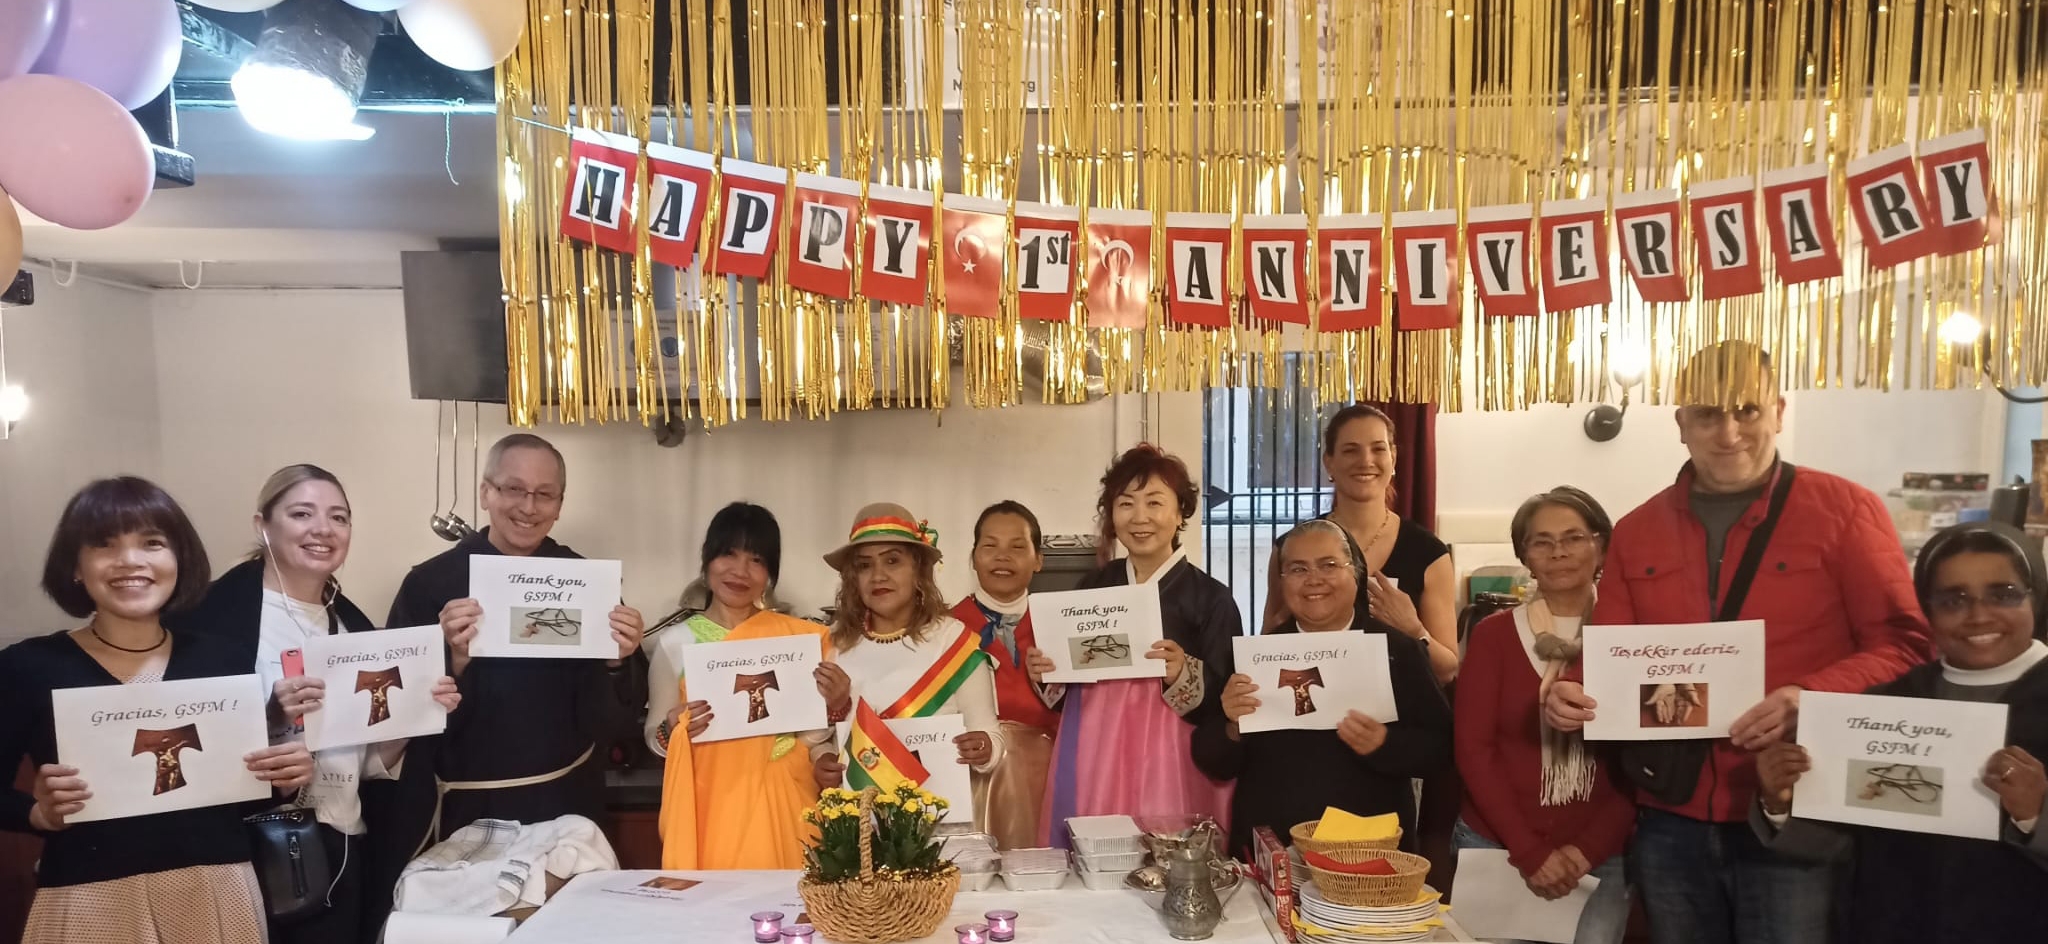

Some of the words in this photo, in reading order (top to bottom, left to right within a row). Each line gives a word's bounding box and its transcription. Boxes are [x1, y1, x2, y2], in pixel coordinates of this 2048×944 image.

[575, 163, 914, 274] HAPPY
[1021, 231, 1071, 290] 1st
[1183, 160, 1978, 306] ANNIVERSARY
[507, 573, 557, 589] Thank
[557, 578, 587, 590] you,
[1060, 604, 1101, 618] Thank
[1102, 605, 1129, 618] you,
[1681, 643, 1741, 657] ederiz,
[326, 651, 380, 669] Gracias,
[706, 657, 756, 672] Gracias,
[1252, 652, 1300, 666] Gracias,
[91, 707, 168, 727] Gracias,
[1846, 717, 1908, 738] Thank
[1908, 725, 1953, 740] you,
